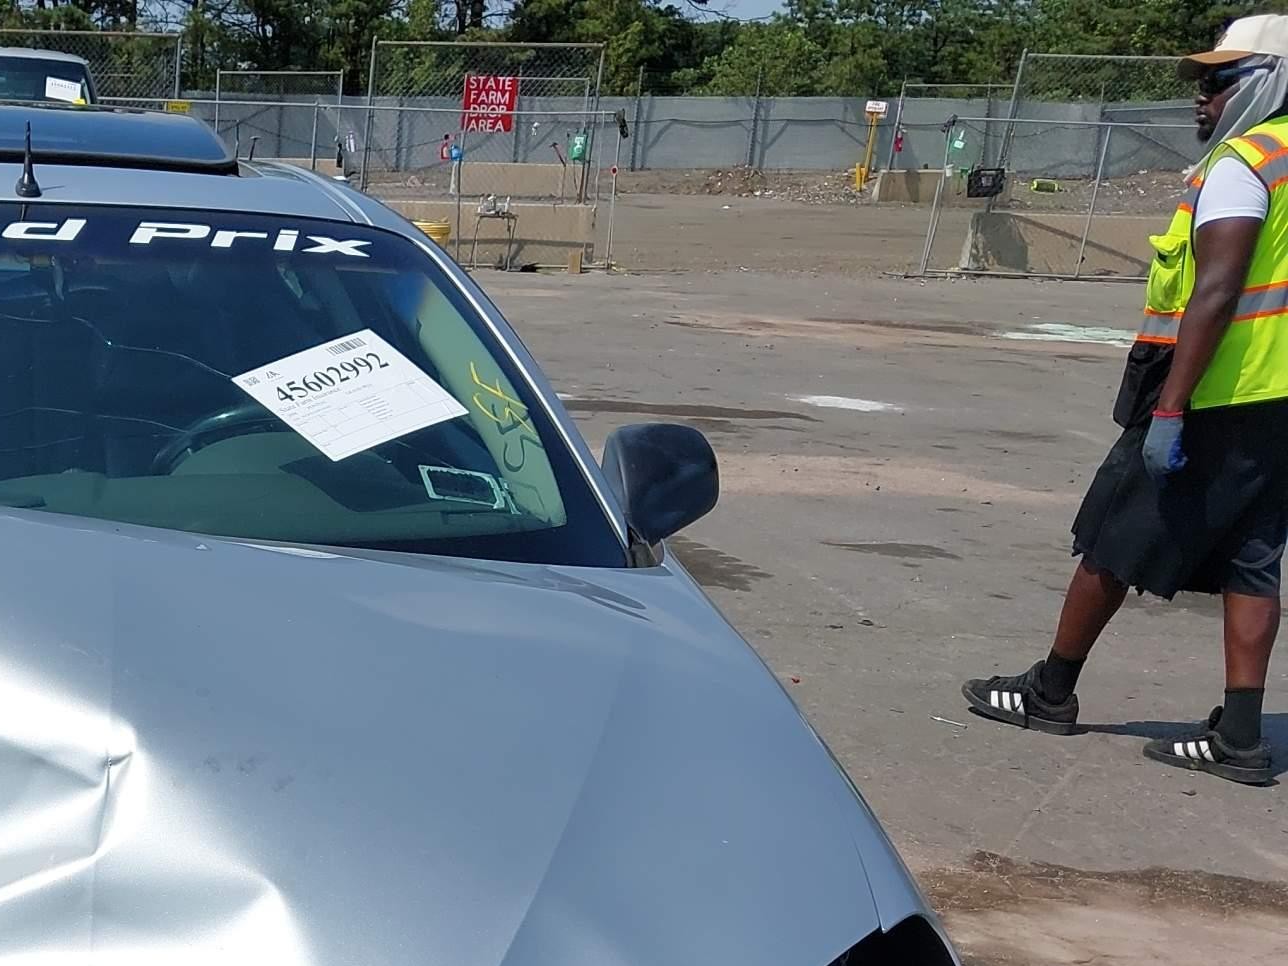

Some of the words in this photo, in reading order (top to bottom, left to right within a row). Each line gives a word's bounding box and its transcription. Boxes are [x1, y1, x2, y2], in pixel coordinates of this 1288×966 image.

[469, 76, 513, 90] STATE
[470, 90, 510, 104] FARM
[469, 104, 507, 117] DROP
[467, 119, 505, 132] AREA
[128, 221, 373, 257] Prix
[276, 352, 390, 403] 45602992
